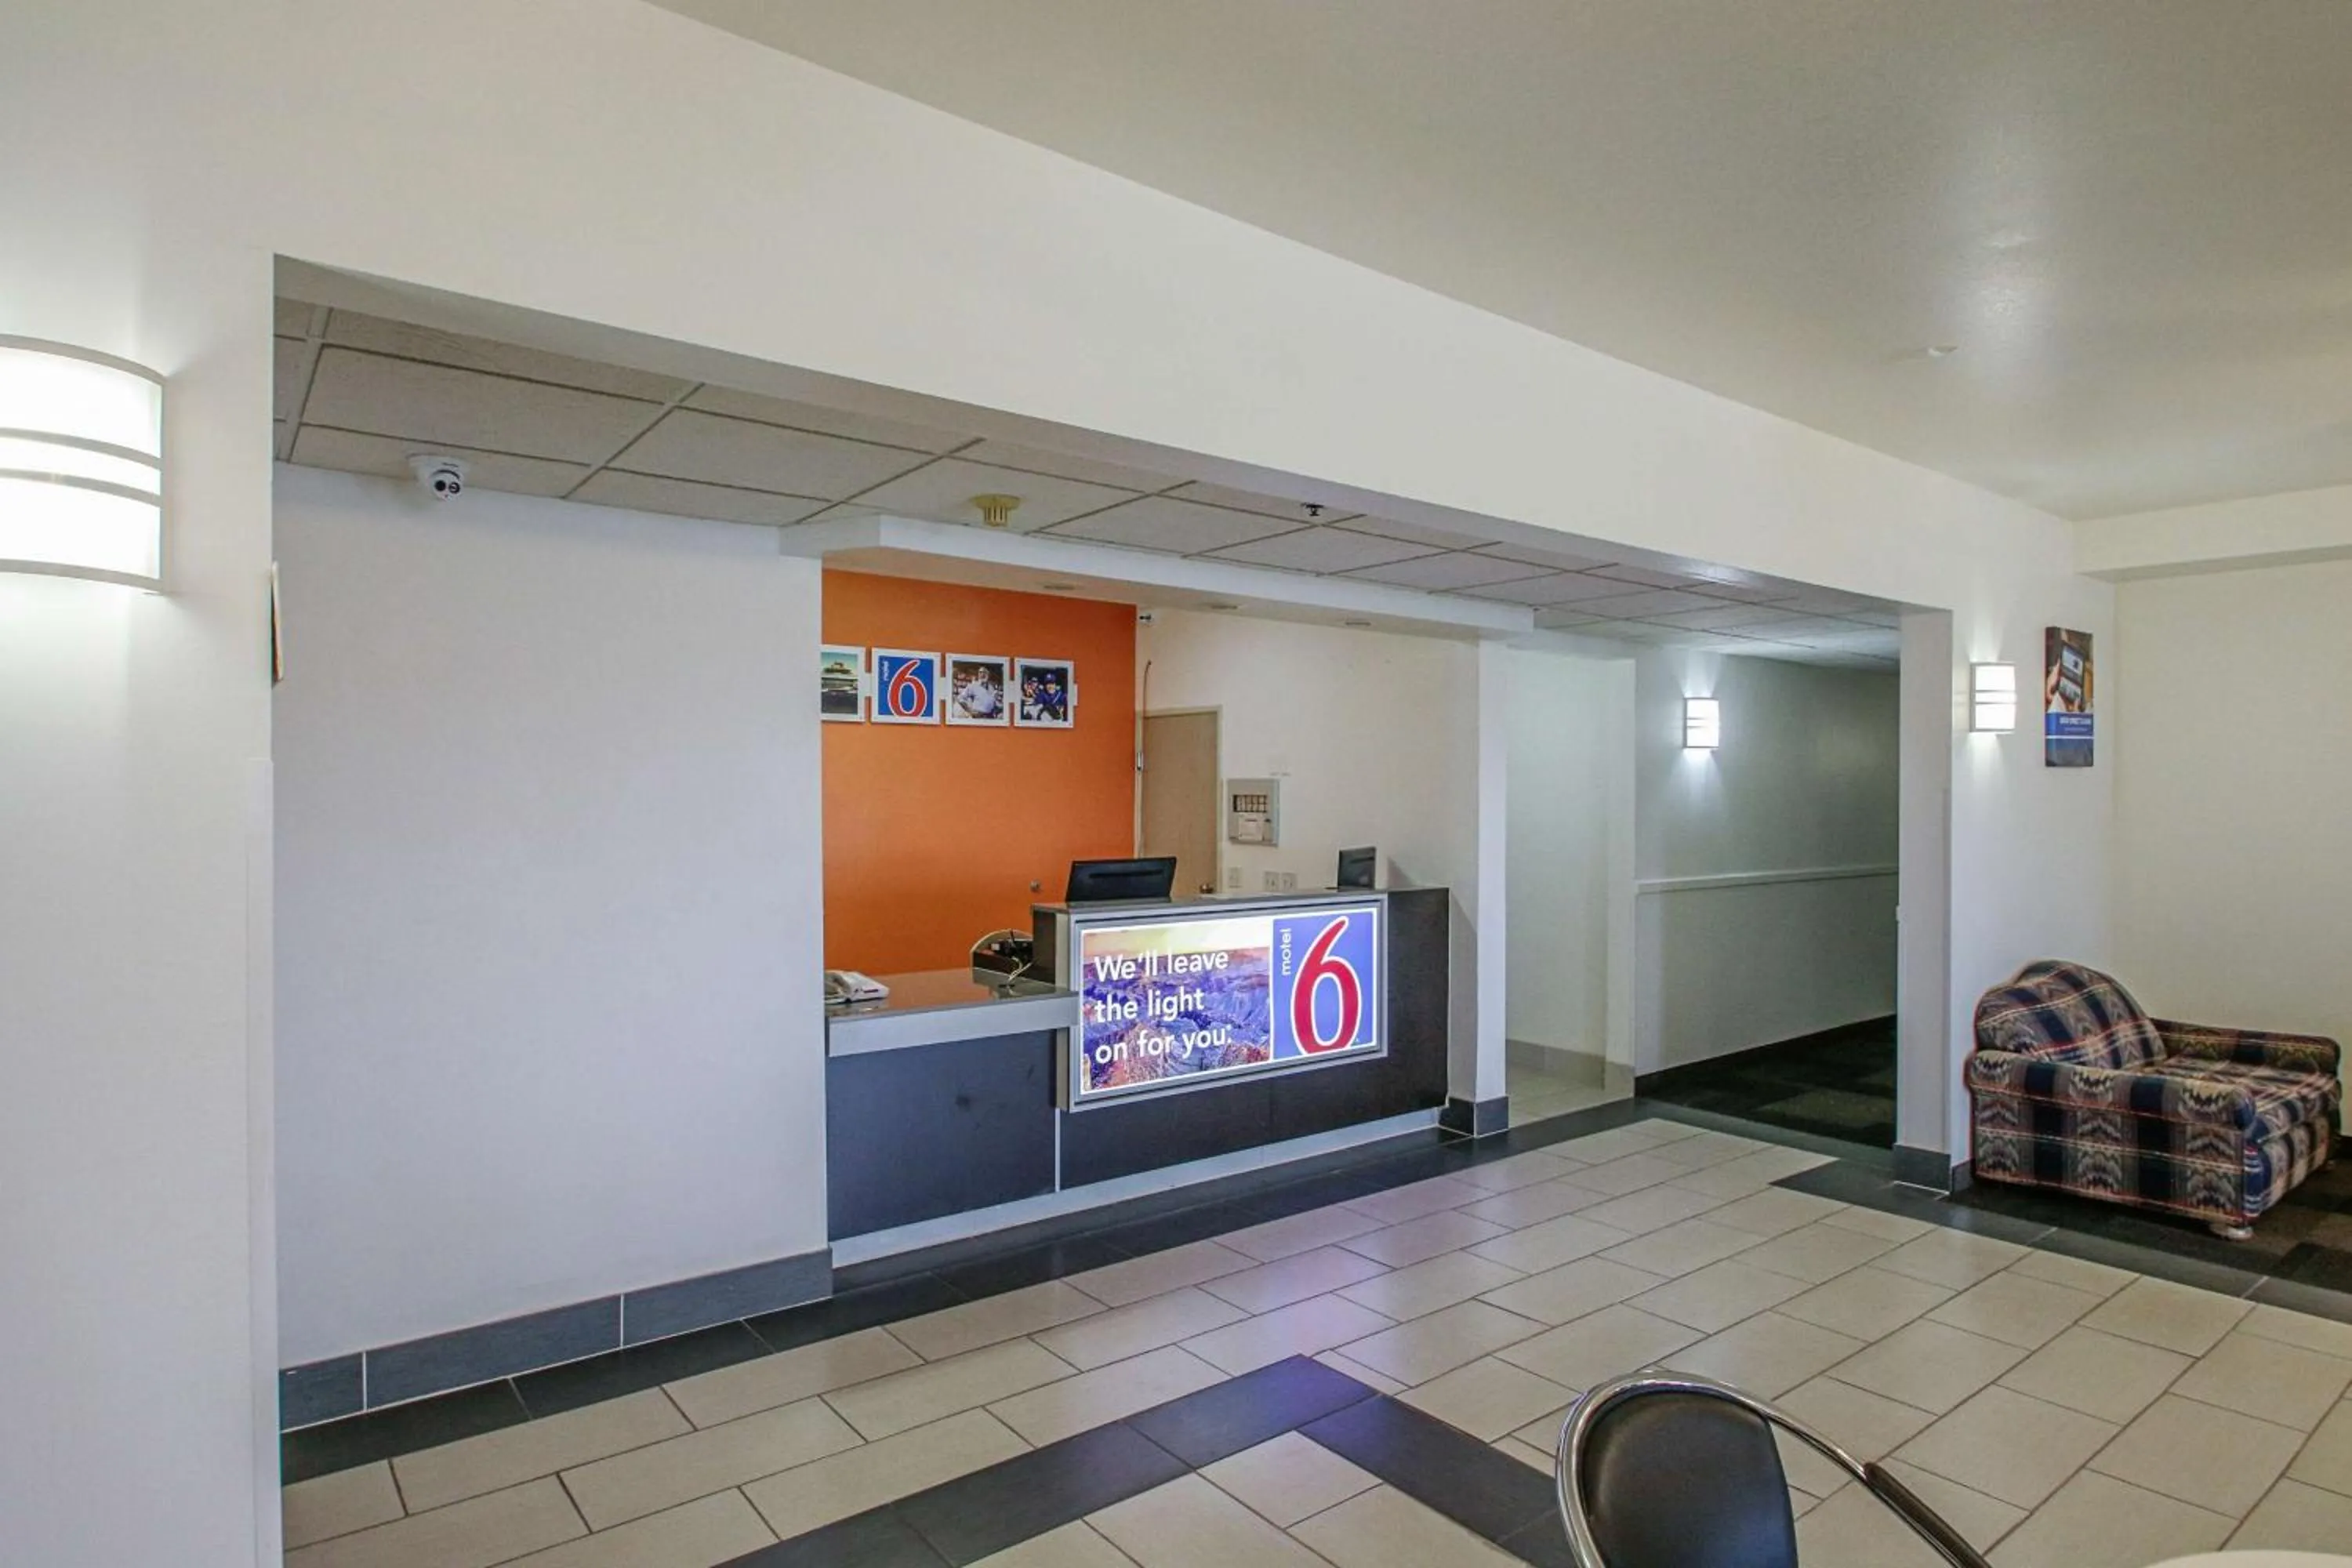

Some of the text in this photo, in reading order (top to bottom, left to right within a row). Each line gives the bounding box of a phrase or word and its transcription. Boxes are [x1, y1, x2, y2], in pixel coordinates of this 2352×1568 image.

[887, 659, 927, 717] 6
[1094, 948, 1229, 982] We'll leave
[1279, 927, 1292, 977] motel
[1094, 985, 1205, 1023] the light
[1290, 915, 1363, 1054] 6
[1095, 1041, 1128, 1064] on
[1137, 1029, 1175, 1058] for
